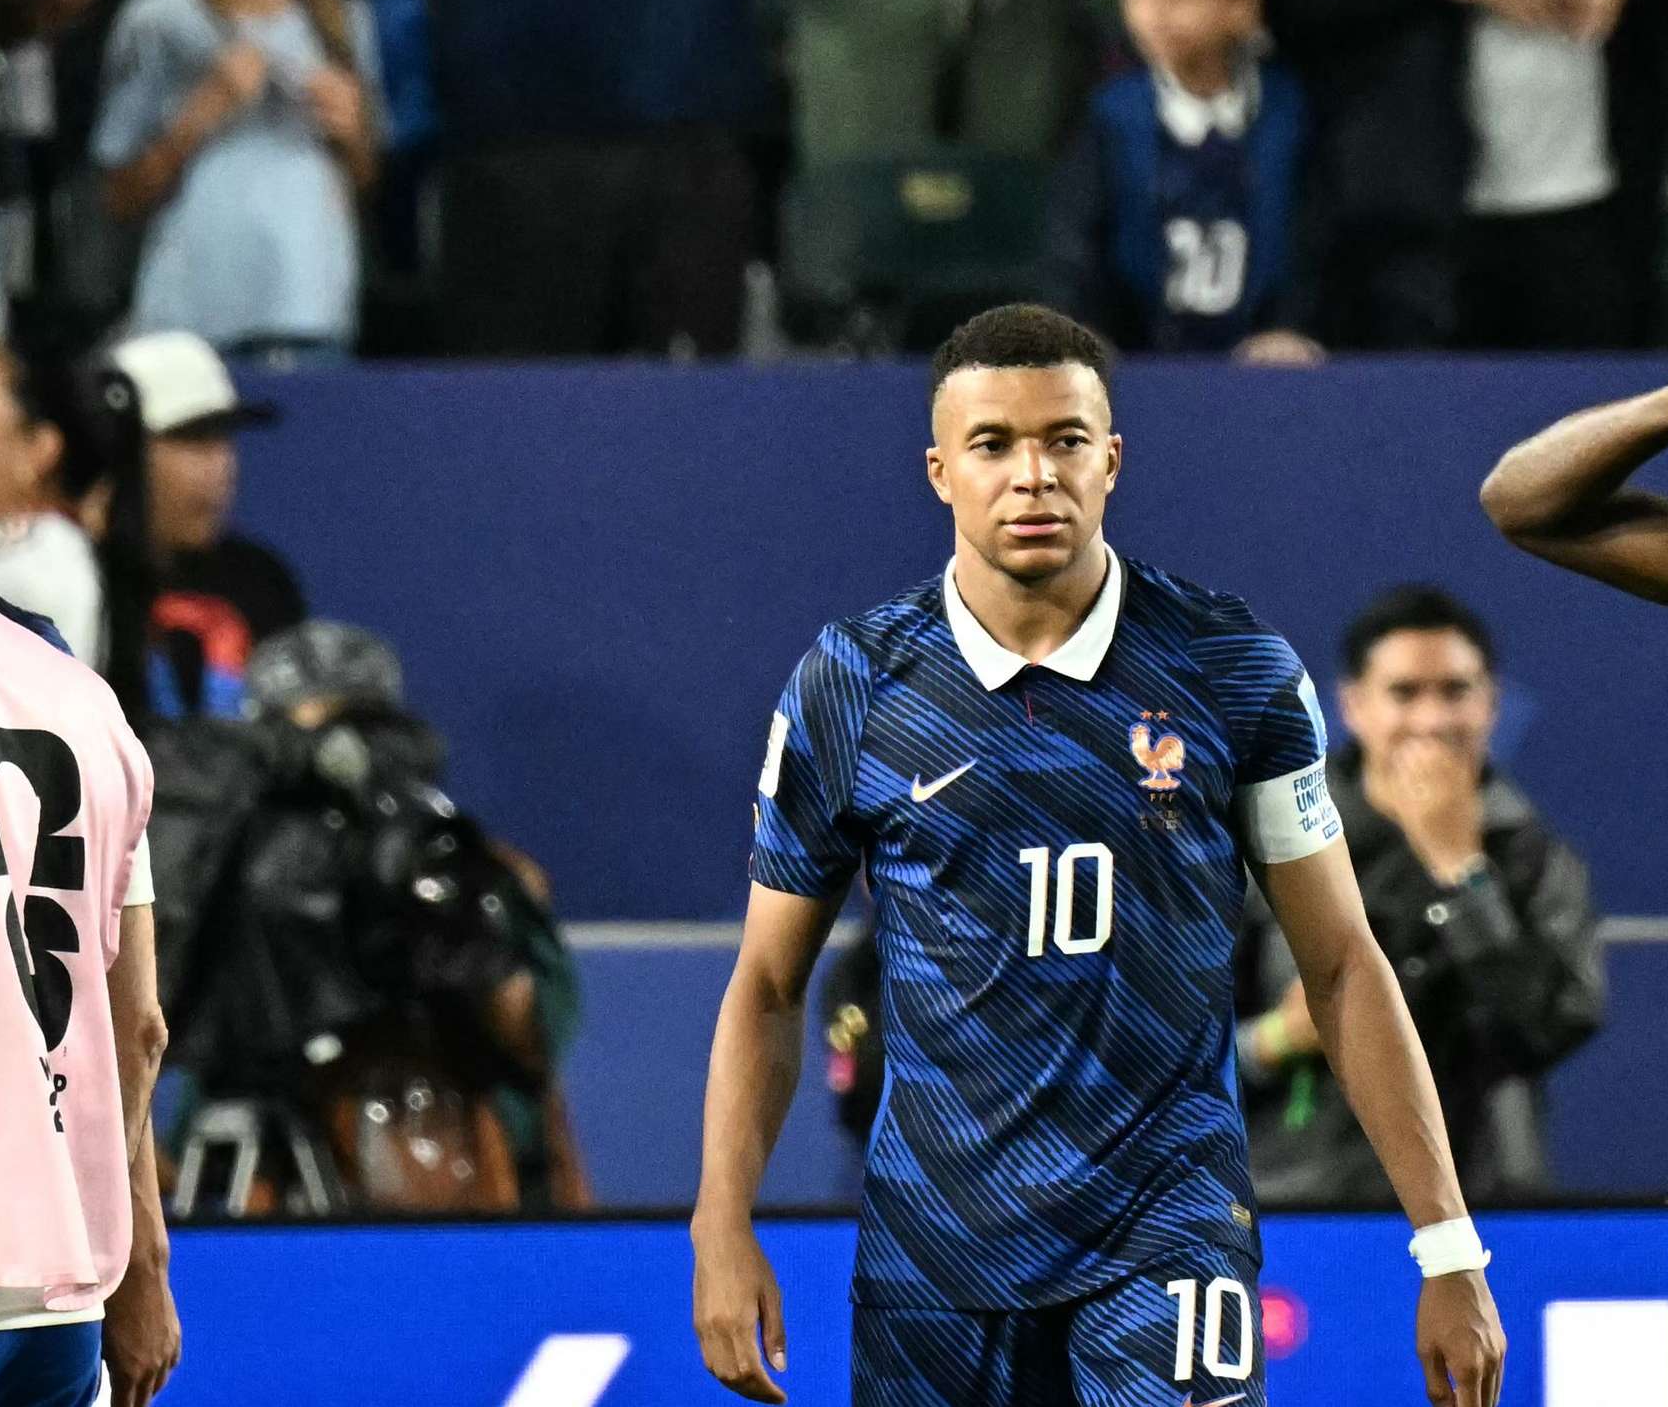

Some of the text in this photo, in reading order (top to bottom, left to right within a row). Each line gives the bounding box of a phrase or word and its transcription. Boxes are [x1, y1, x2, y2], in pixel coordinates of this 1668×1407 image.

[1293, 767, 1325, 793] FOOTB
[1295, 782, 1328, 813] UNIT
[1019, 842, 1114, 957] 10
[1167, 1276, 1254, 1381] 10
